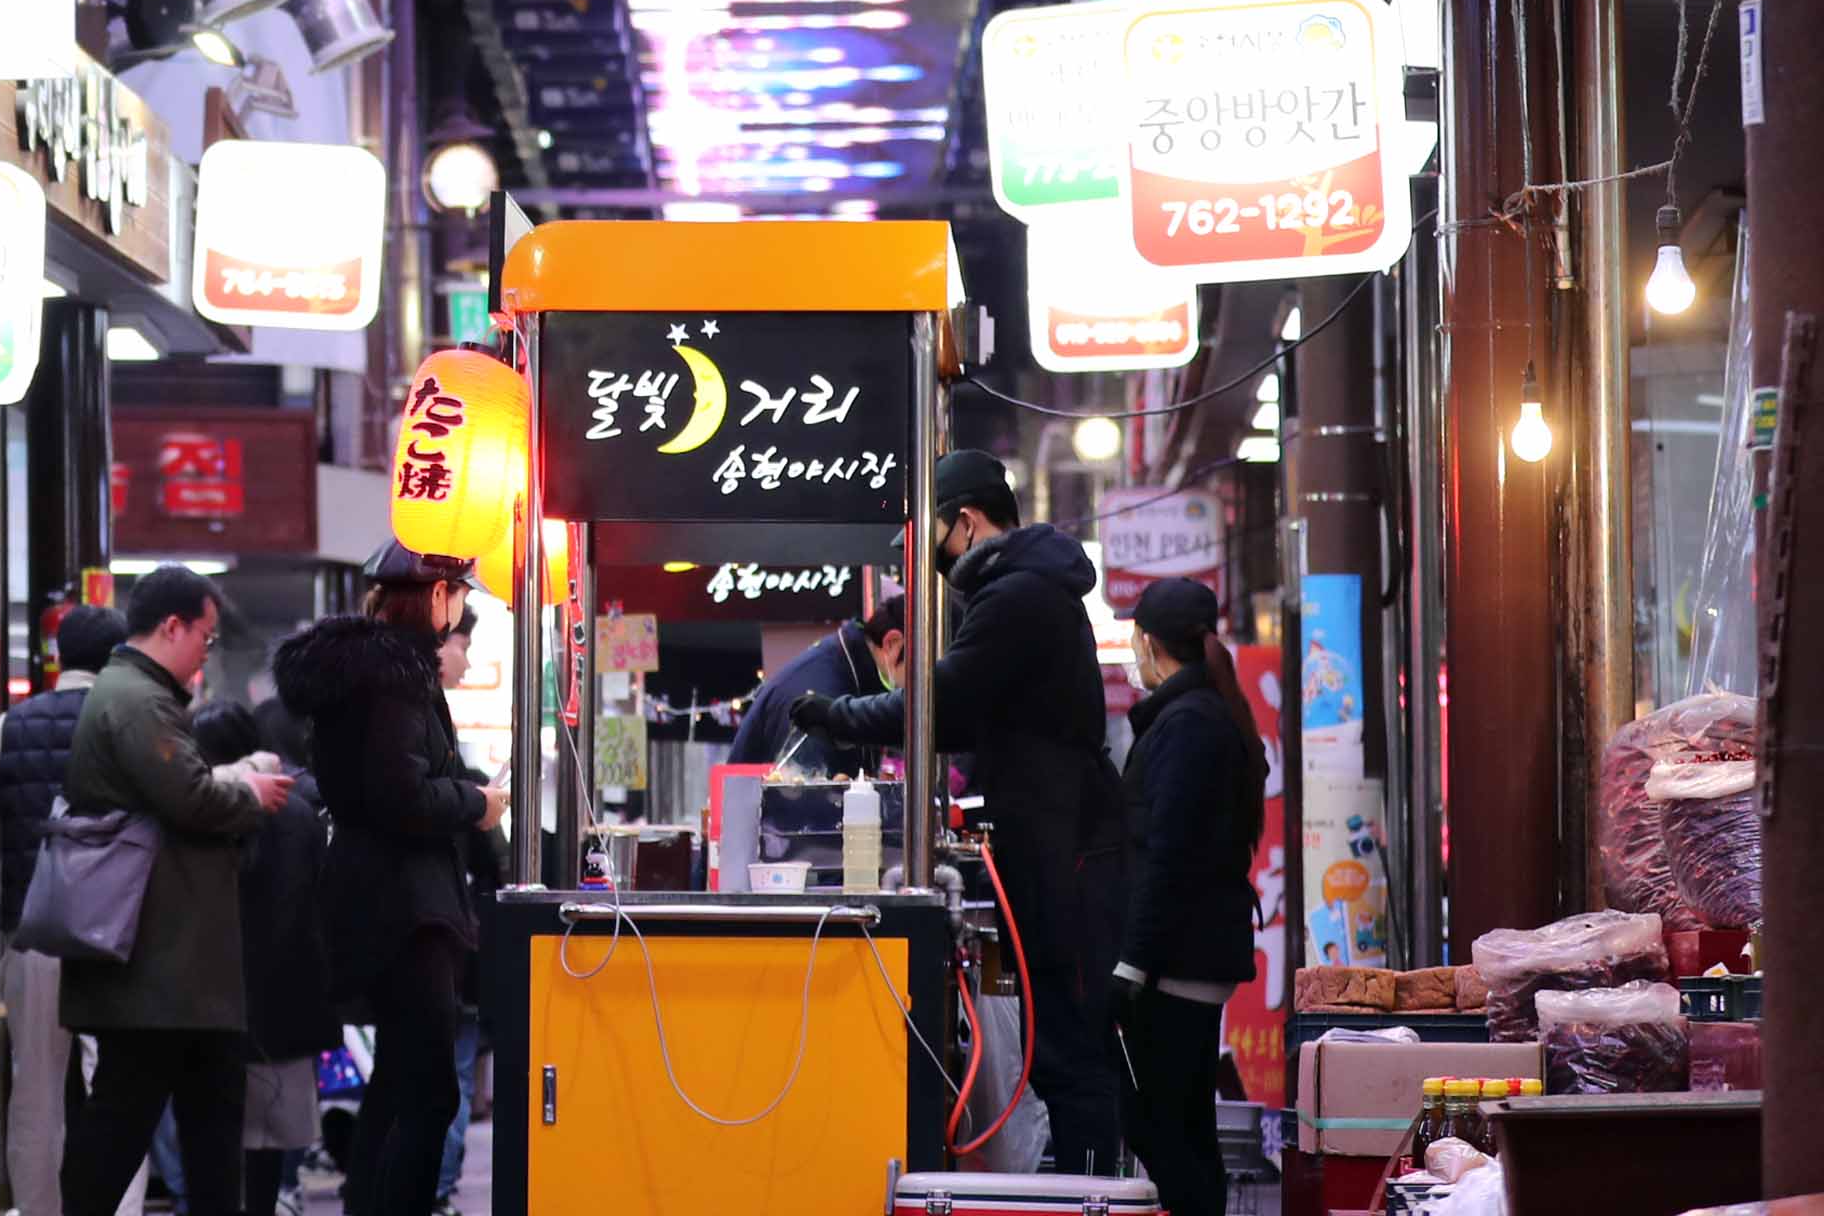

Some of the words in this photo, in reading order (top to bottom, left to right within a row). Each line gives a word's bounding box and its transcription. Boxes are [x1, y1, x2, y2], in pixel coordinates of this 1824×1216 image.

[1138, 81, 1367, 155] 중앙방앗간
[1160, 190, 1355, 237] 762-1292
[397, 375, 465, 502] たこ焼
[585, 369, 679, 440] 달빛
[739, 374, 861, 427] 거리
[712, 444, 897, 495] 송현야시장
